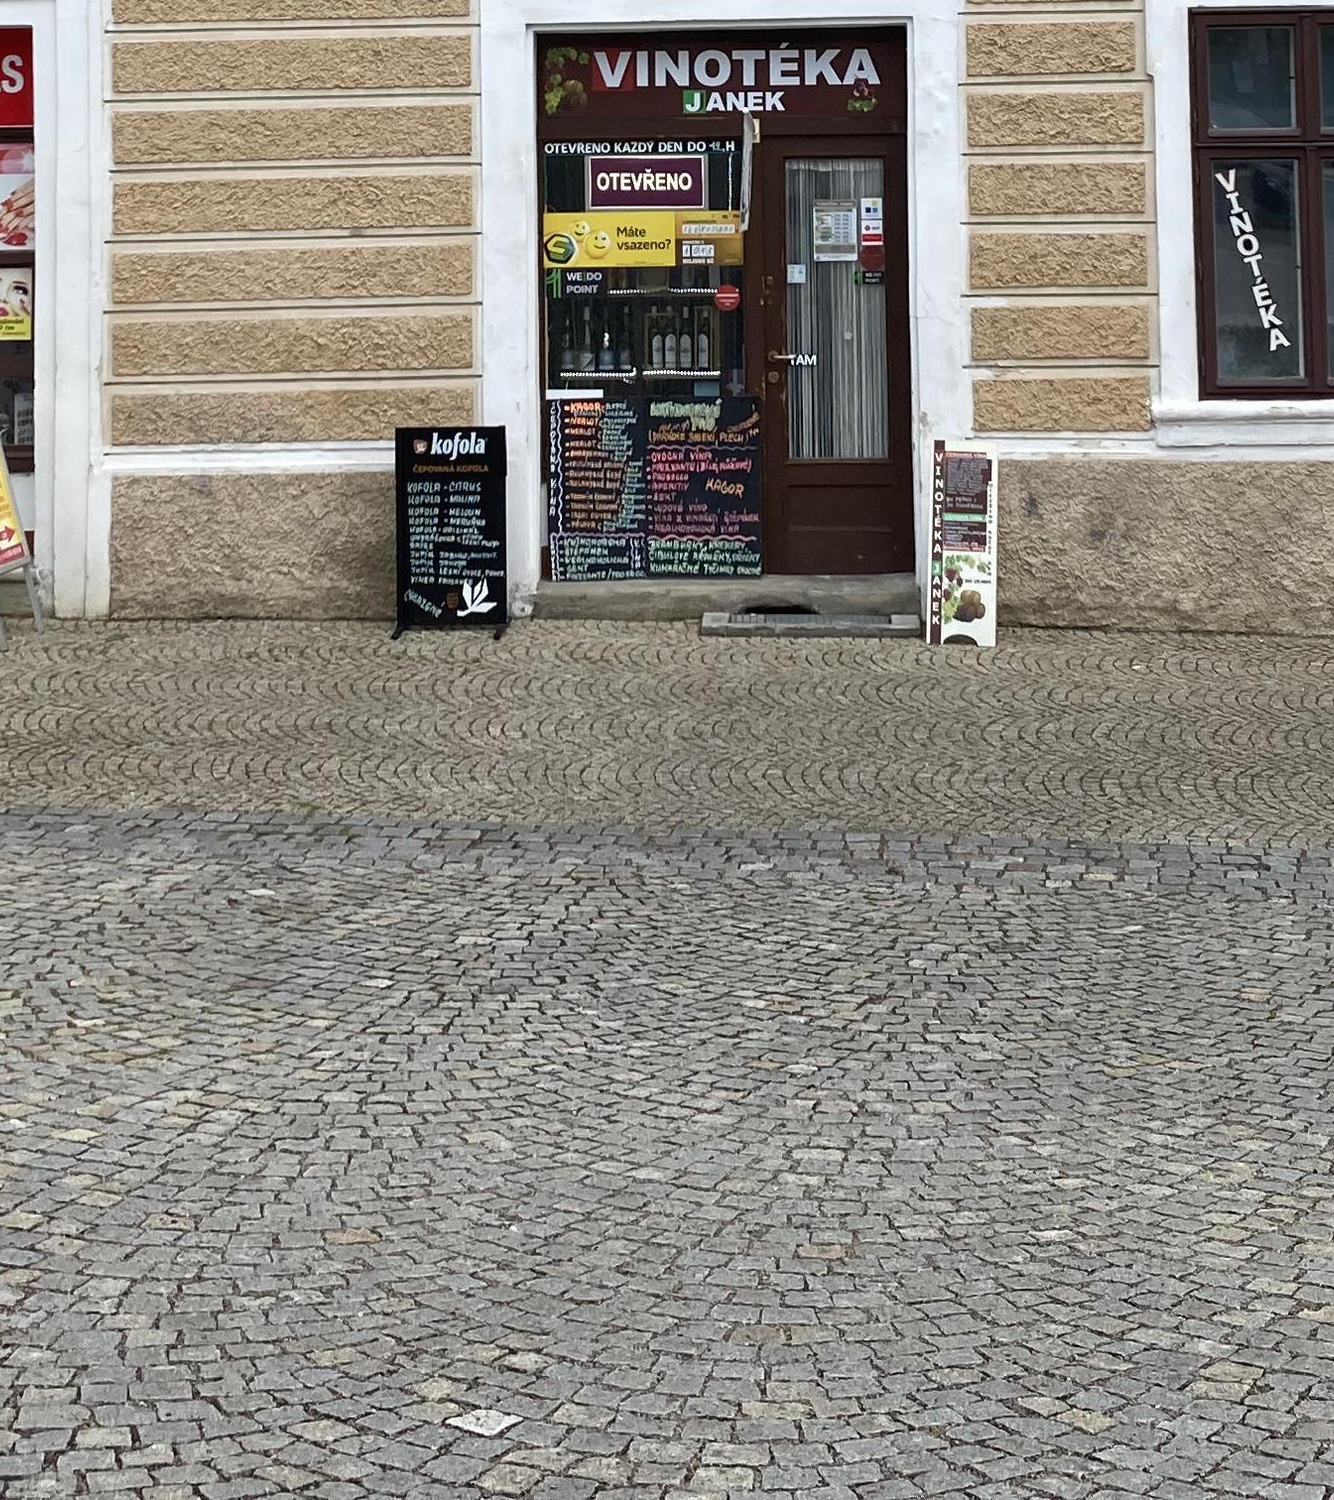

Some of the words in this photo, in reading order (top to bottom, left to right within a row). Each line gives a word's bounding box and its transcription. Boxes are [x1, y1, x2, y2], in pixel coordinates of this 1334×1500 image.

[595, 42, 881, 88] VINOTÉKA
[685, 91, 785, 112] JANEK
[658, 142, 683, 152] DEN
[687, 141, 706, 152] DO
[596, 169, 692, 191] OTEVŘENO
[617, 226, 646, 238] Máte
[616, 239, 671, 251] vsazeno?
[1214, 169, 1291, 352] VINOTÉKA
[567, 285, 598, 294] POINT
[430, 431, 485, 461] kofola
[407, 481, 441, 493] KOFOLA
[449, 481, 482, 492] CITRUS
[705, 477, 745, 499] KAGOR
[407, 494, 441, 504] KOFOLA
[934, 452, 945, 554] VINOTÉKA
[408, 507, 439, 516] KOFOLA
[409, 517, 438, 525] KOFOLA
[932, 563, 942, 625] JANEK
